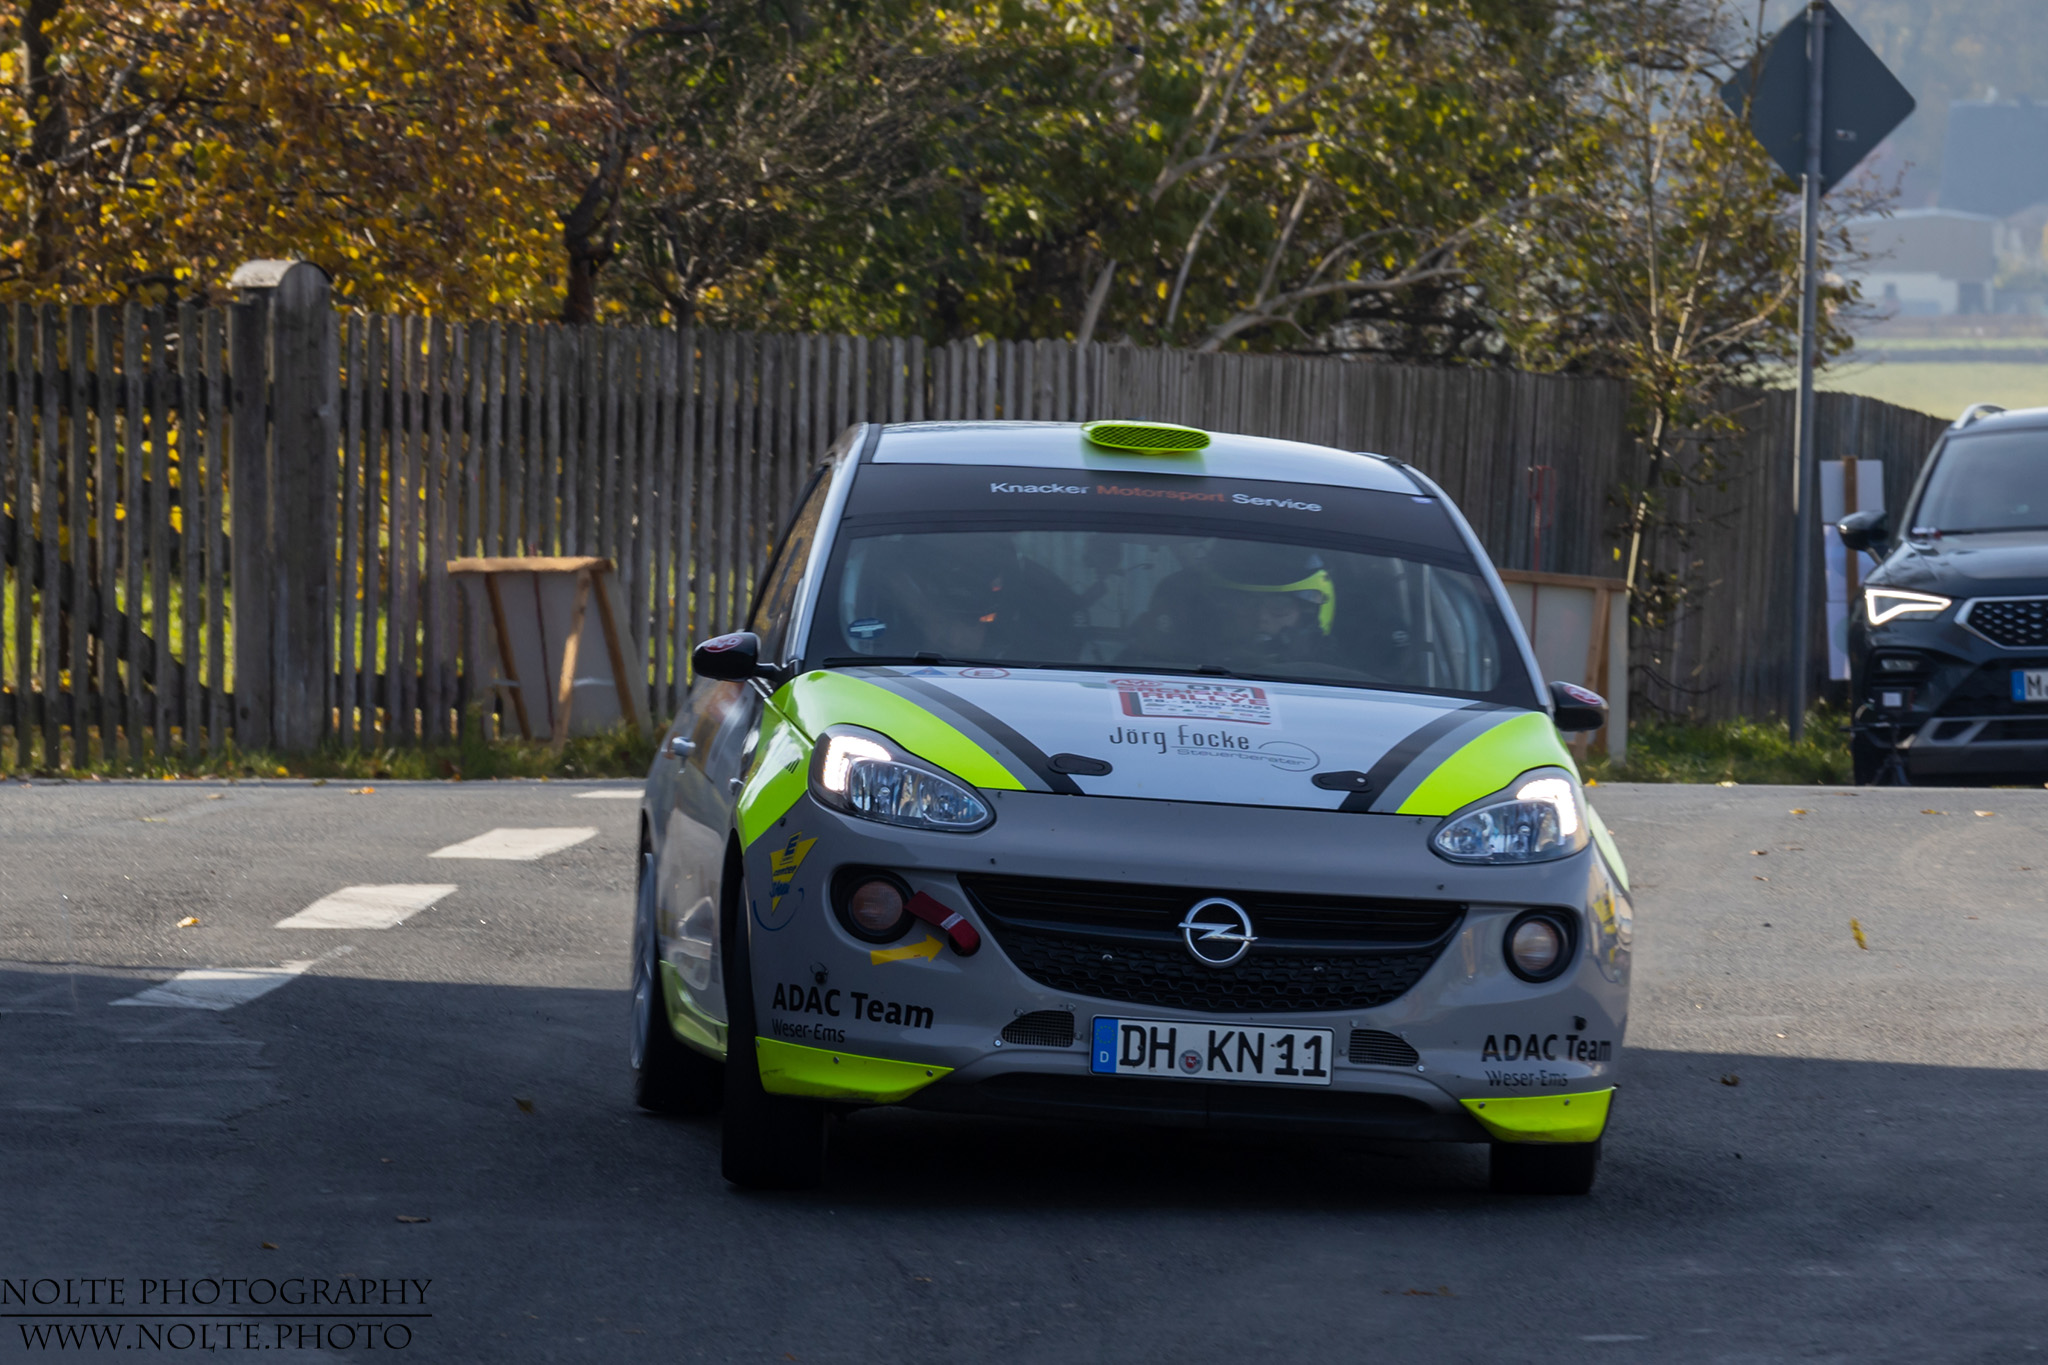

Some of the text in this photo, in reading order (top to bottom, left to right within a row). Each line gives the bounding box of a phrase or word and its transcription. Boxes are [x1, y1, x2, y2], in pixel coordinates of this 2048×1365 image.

[990, 482, 1322, 512] Knacker Motorsport Service
[1142, 691, 1269, 707] RALLYE
[1109, 726, 1167, 754] Jörg
[1177, 749, 1306, 766] Steuerberater
[771, 982, 934, 1029] ADAC Team
[771, 1018, 845, 1043] Weser-Ems
[1100, 1024, 1327, 1078] D DH KN 11
[1481, 1033, 1612, 1062] ADAC Team
[1485, 1069, 1569, 1087] Weser-Ems
